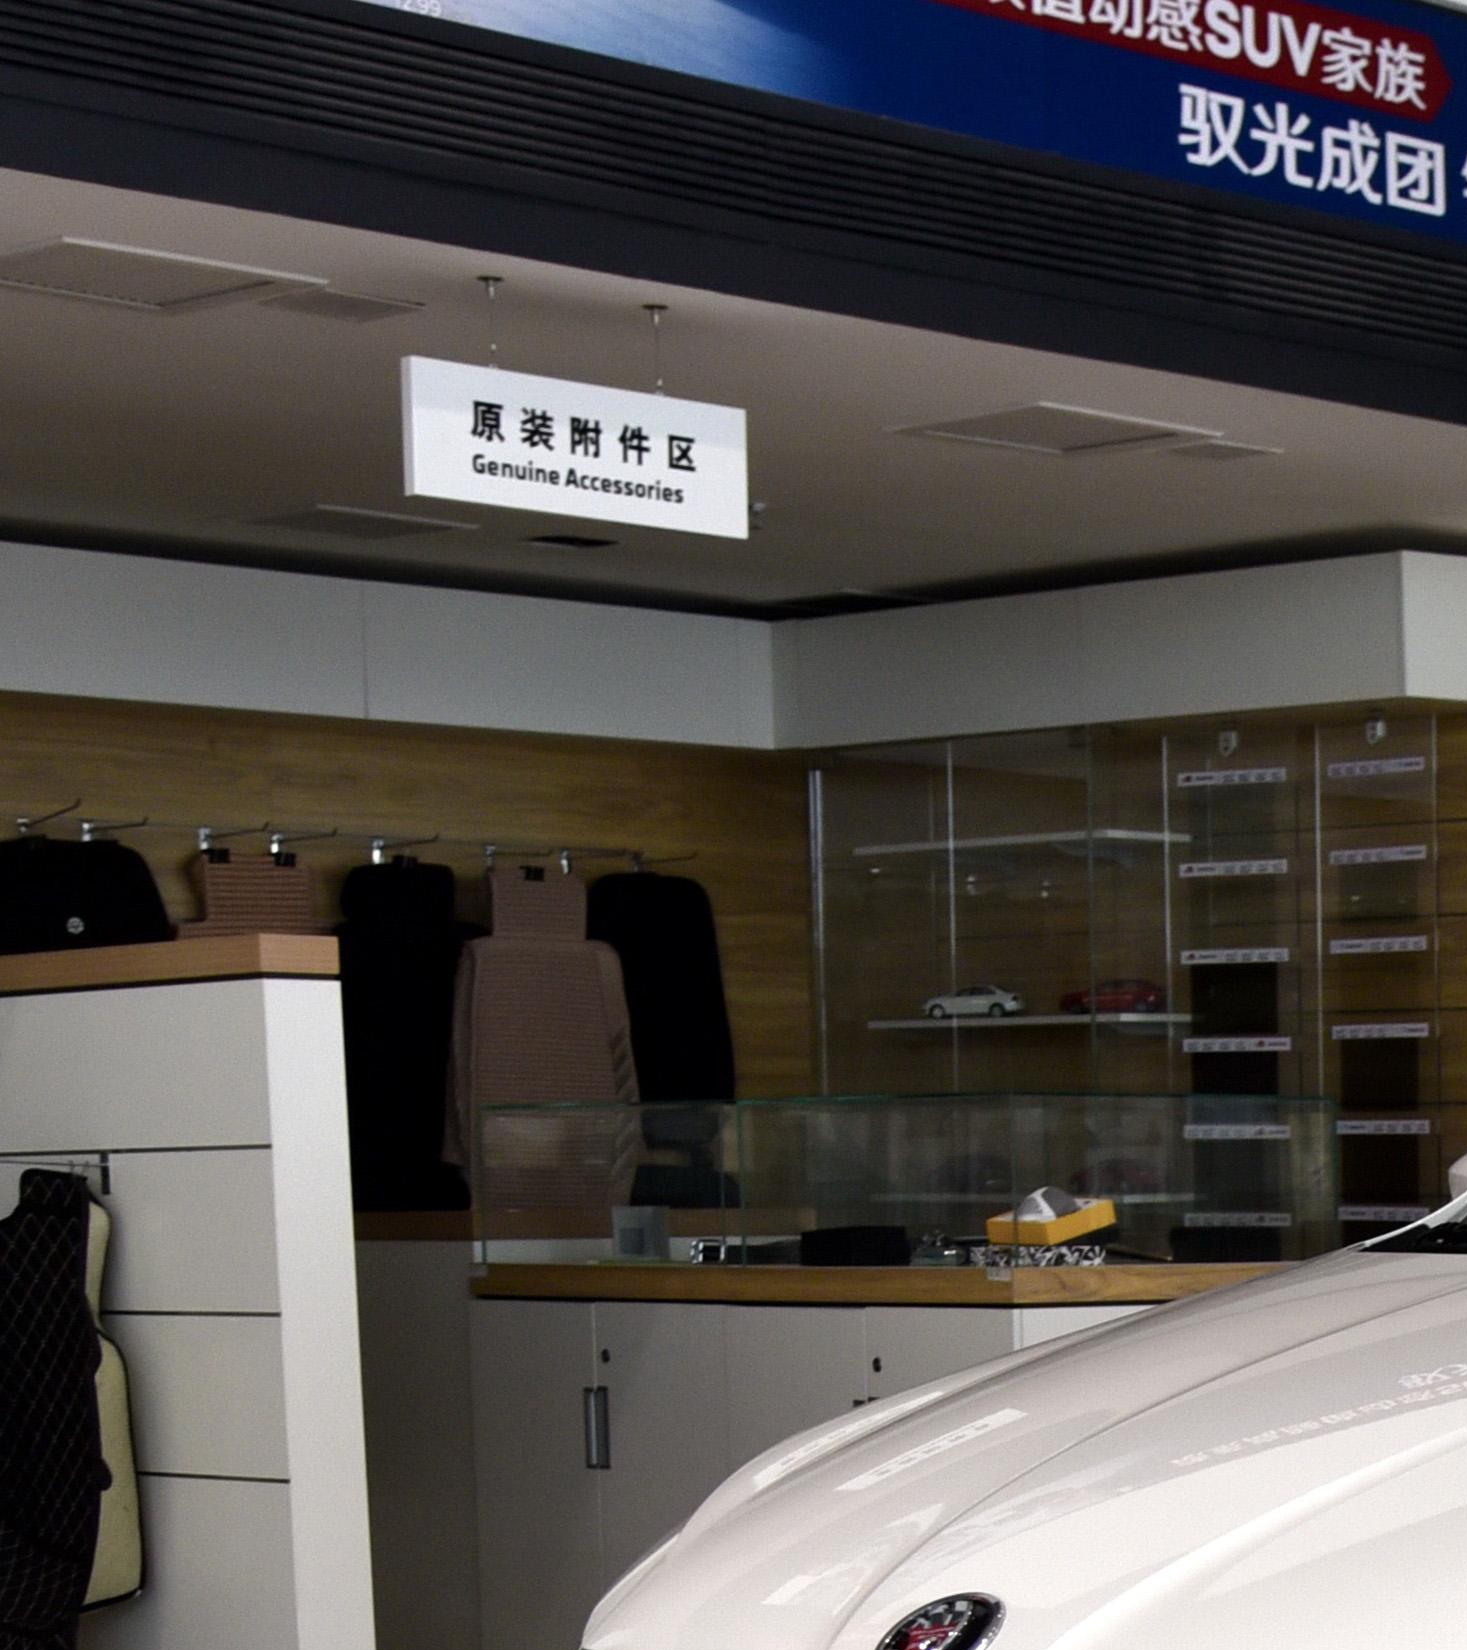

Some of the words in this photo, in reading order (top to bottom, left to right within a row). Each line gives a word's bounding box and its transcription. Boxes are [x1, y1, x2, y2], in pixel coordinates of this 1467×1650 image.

[1178, 83, 1447, 217] 驭光成团
[470, 400, 696, 472] 原装附件区
[472, 453, 560, 485] Genuine
[565, 468, 684, 503] Accessories
